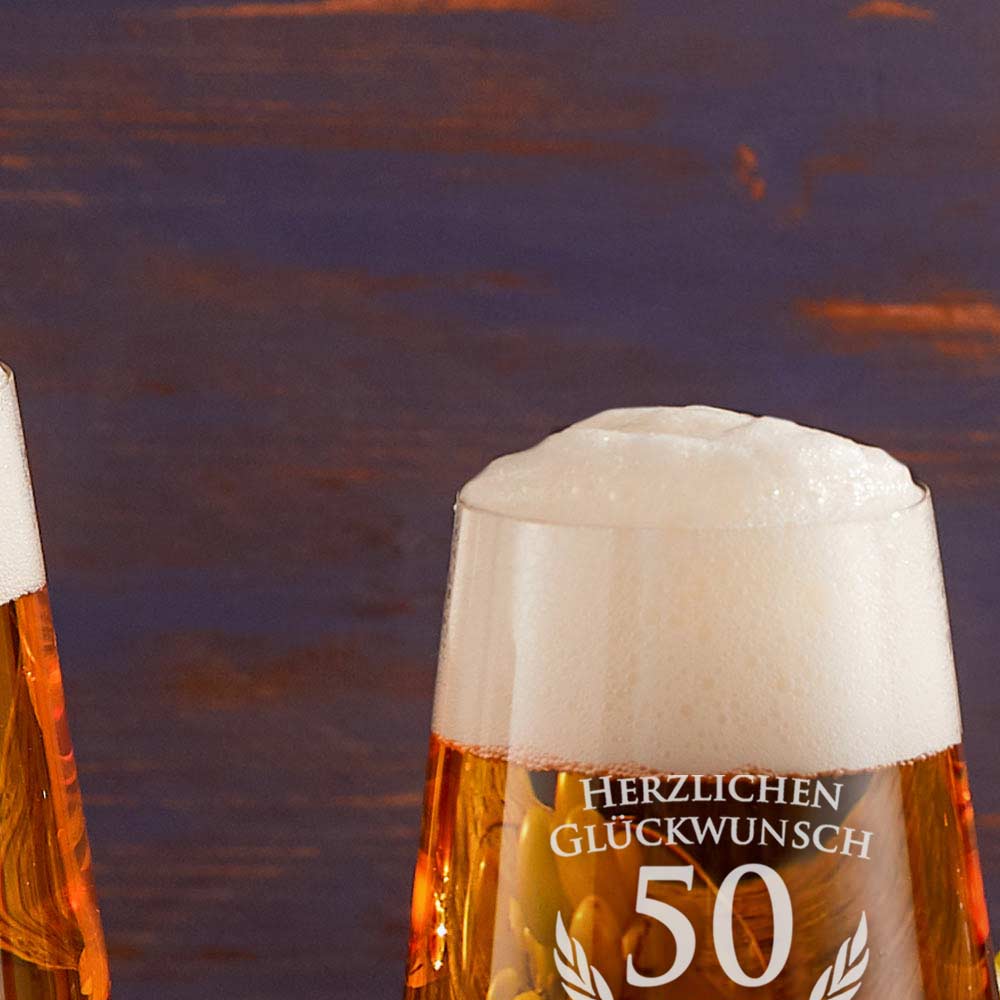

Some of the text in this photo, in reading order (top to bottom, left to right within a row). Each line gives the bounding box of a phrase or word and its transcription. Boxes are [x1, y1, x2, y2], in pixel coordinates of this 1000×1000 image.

[580, 774, 844, 811] HERZLICHEN
[549, 815, 874, 860] GLÜCKWUNSCH
[625, 863, 794, 988] 50
